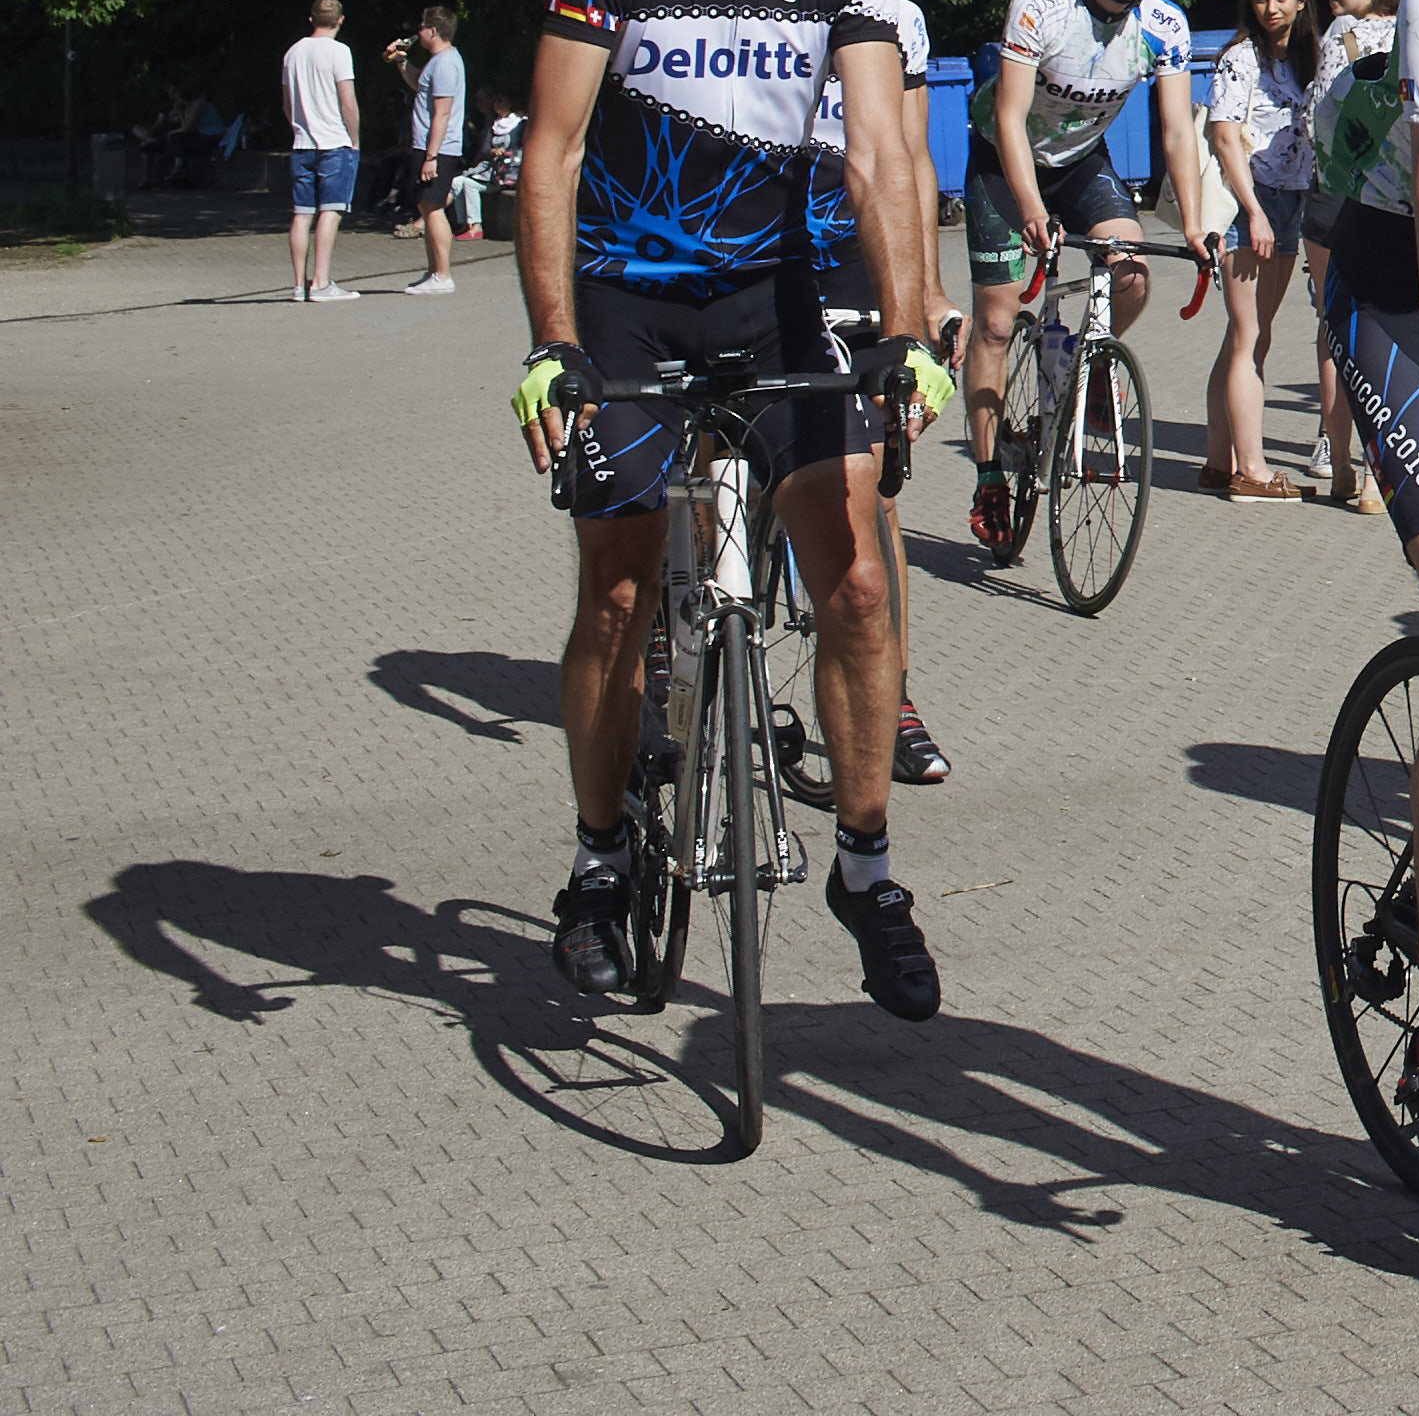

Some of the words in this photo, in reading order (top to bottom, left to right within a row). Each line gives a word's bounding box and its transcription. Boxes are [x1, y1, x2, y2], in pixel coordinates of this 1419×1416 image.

[627, 39, 813, 80] Deloitte
[1320, 319, 1344, 365] OUR
[1343, 357, 1393, 432] EUCOR
[577, 426, 616, 483] 2016
